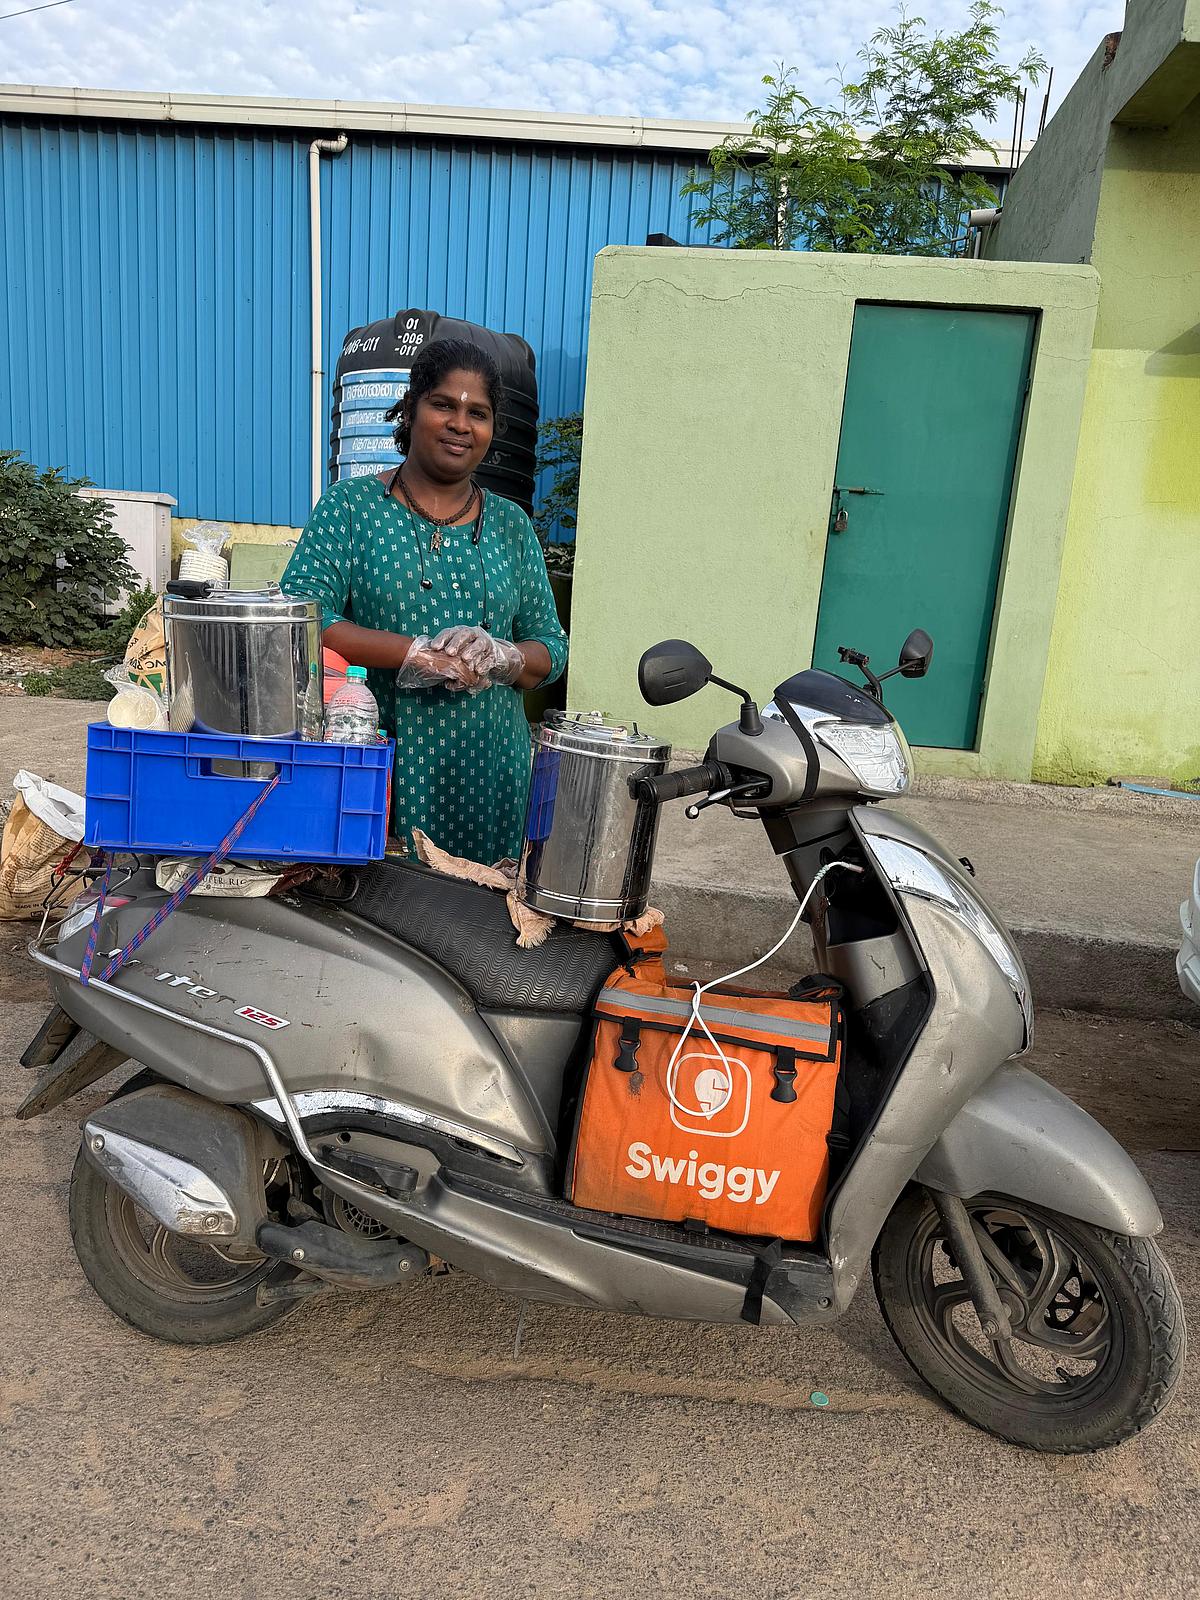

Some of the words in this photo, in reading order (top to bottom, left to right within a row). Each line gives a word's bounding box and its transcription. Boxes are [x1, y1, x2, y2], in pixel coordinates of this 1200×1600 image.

[405, 317, 420, 330] 01
[397, 332, 424, 345] -008
[394, 345, 418, 356] -011
[240, 1007, 283, 1027] 125
[624, 1141, 781, 1205] Swiggy
